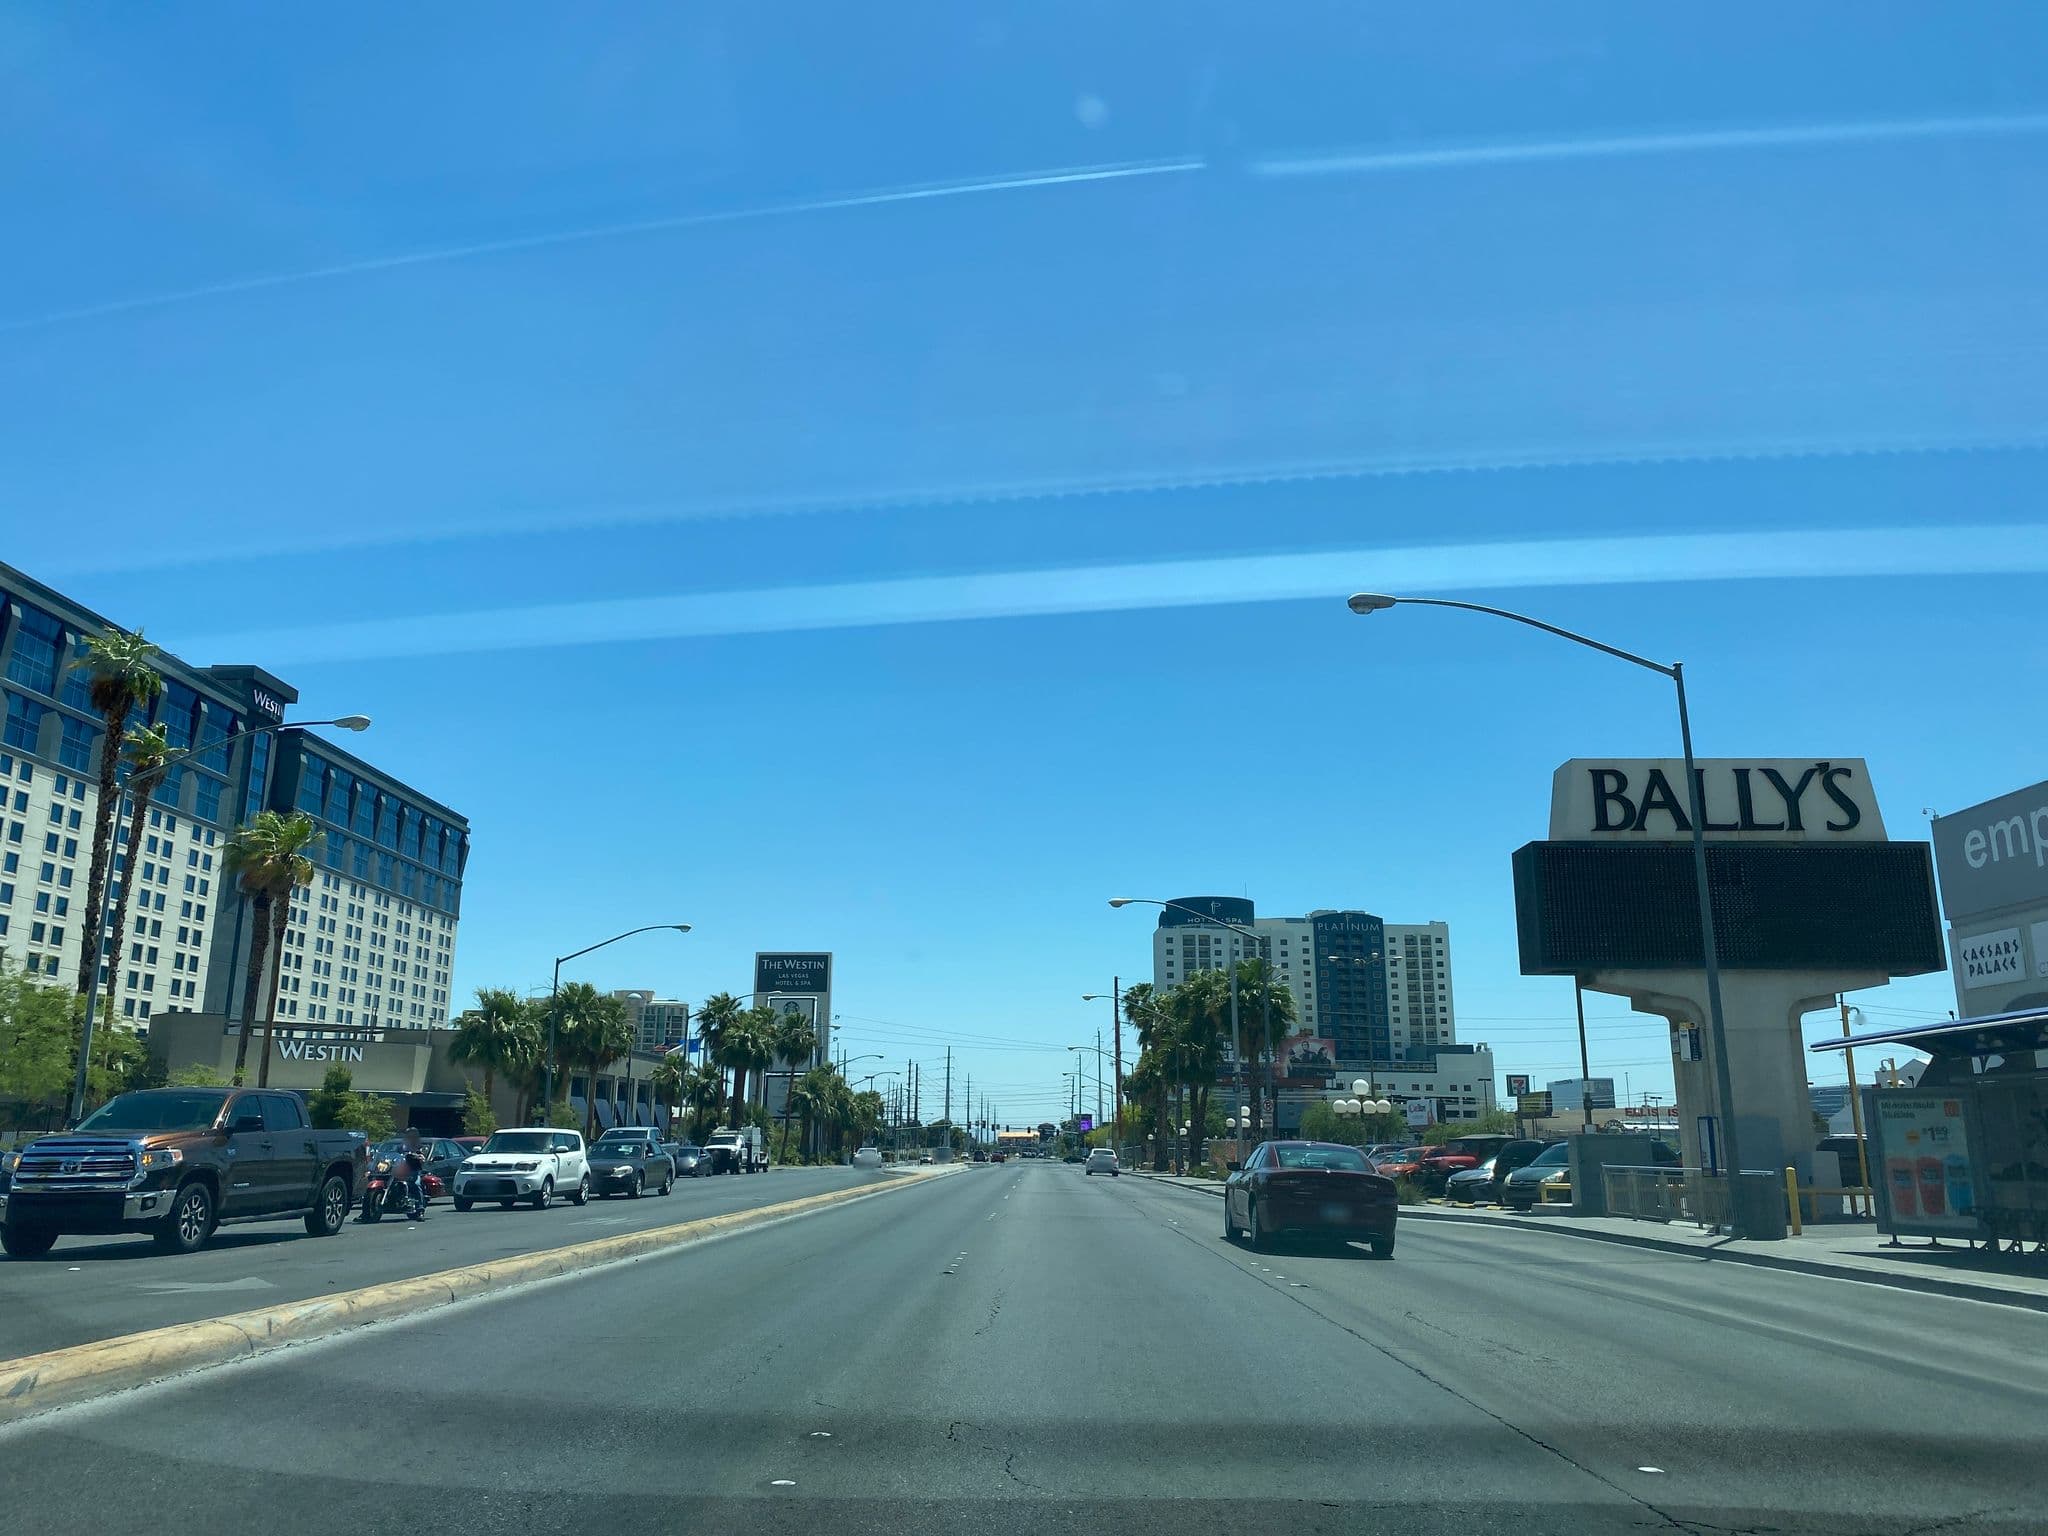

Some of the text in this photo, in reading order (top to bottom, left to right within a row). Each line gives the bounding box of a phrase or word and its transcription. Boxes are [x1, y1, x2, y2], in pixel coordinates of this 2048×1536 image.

[1588, 762, 1860, 832] BALLY'S
[1317, 920, 1380, 931] PLATINUM
[1962, 939, 2019, 962] CAESARS
[762, 959, 825, 970] THE WESTIN
[1968, 957, 2017, 978] PALACE
[278, 1040, 363, 1062] WESTIN
[1625, 1107, 1659, 1117] ELLIS
